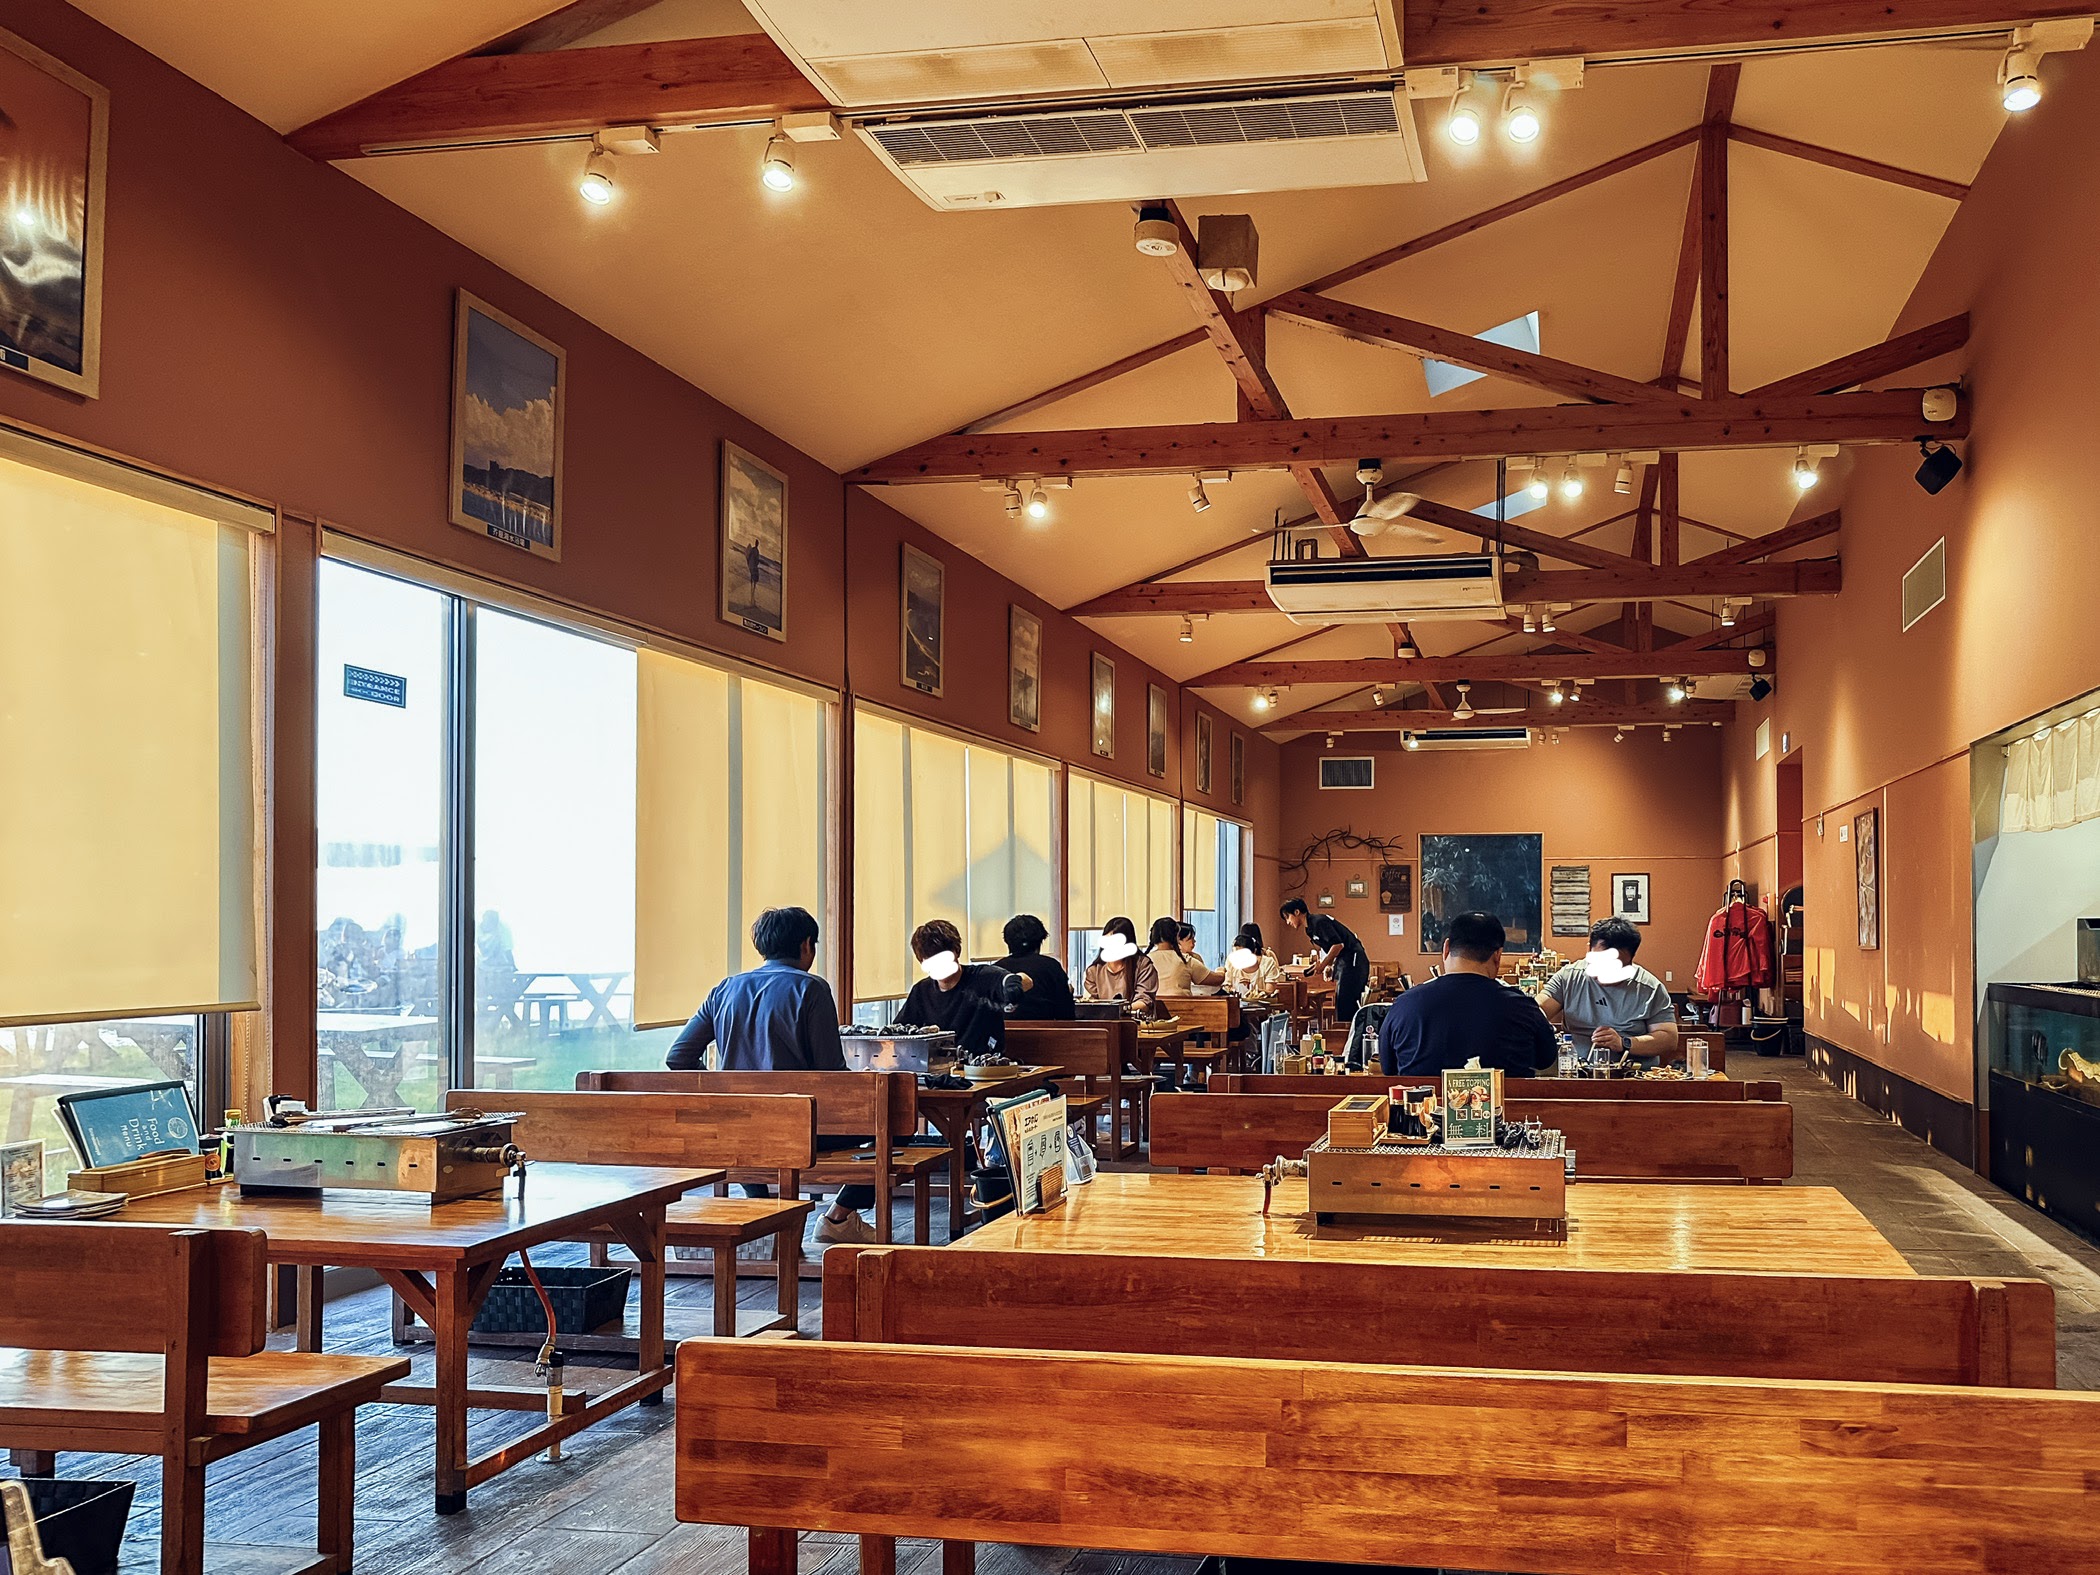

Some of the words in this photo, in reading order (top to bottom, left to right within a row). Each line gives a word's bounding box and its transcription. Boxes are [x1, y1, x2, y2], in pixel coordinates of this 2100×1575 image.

[371, 691, 401, 702] DOOR
[1452, 1079, 1466, 1088] FREE
[1466, 1078, 1491, 1087] TOPPING
[120, 1124, 133, 1148] Menu
[128, 1118, 148, 1151] Drink
[142, 1125, 153, 1141] and
[147, 1117, 166, 1145] Food
